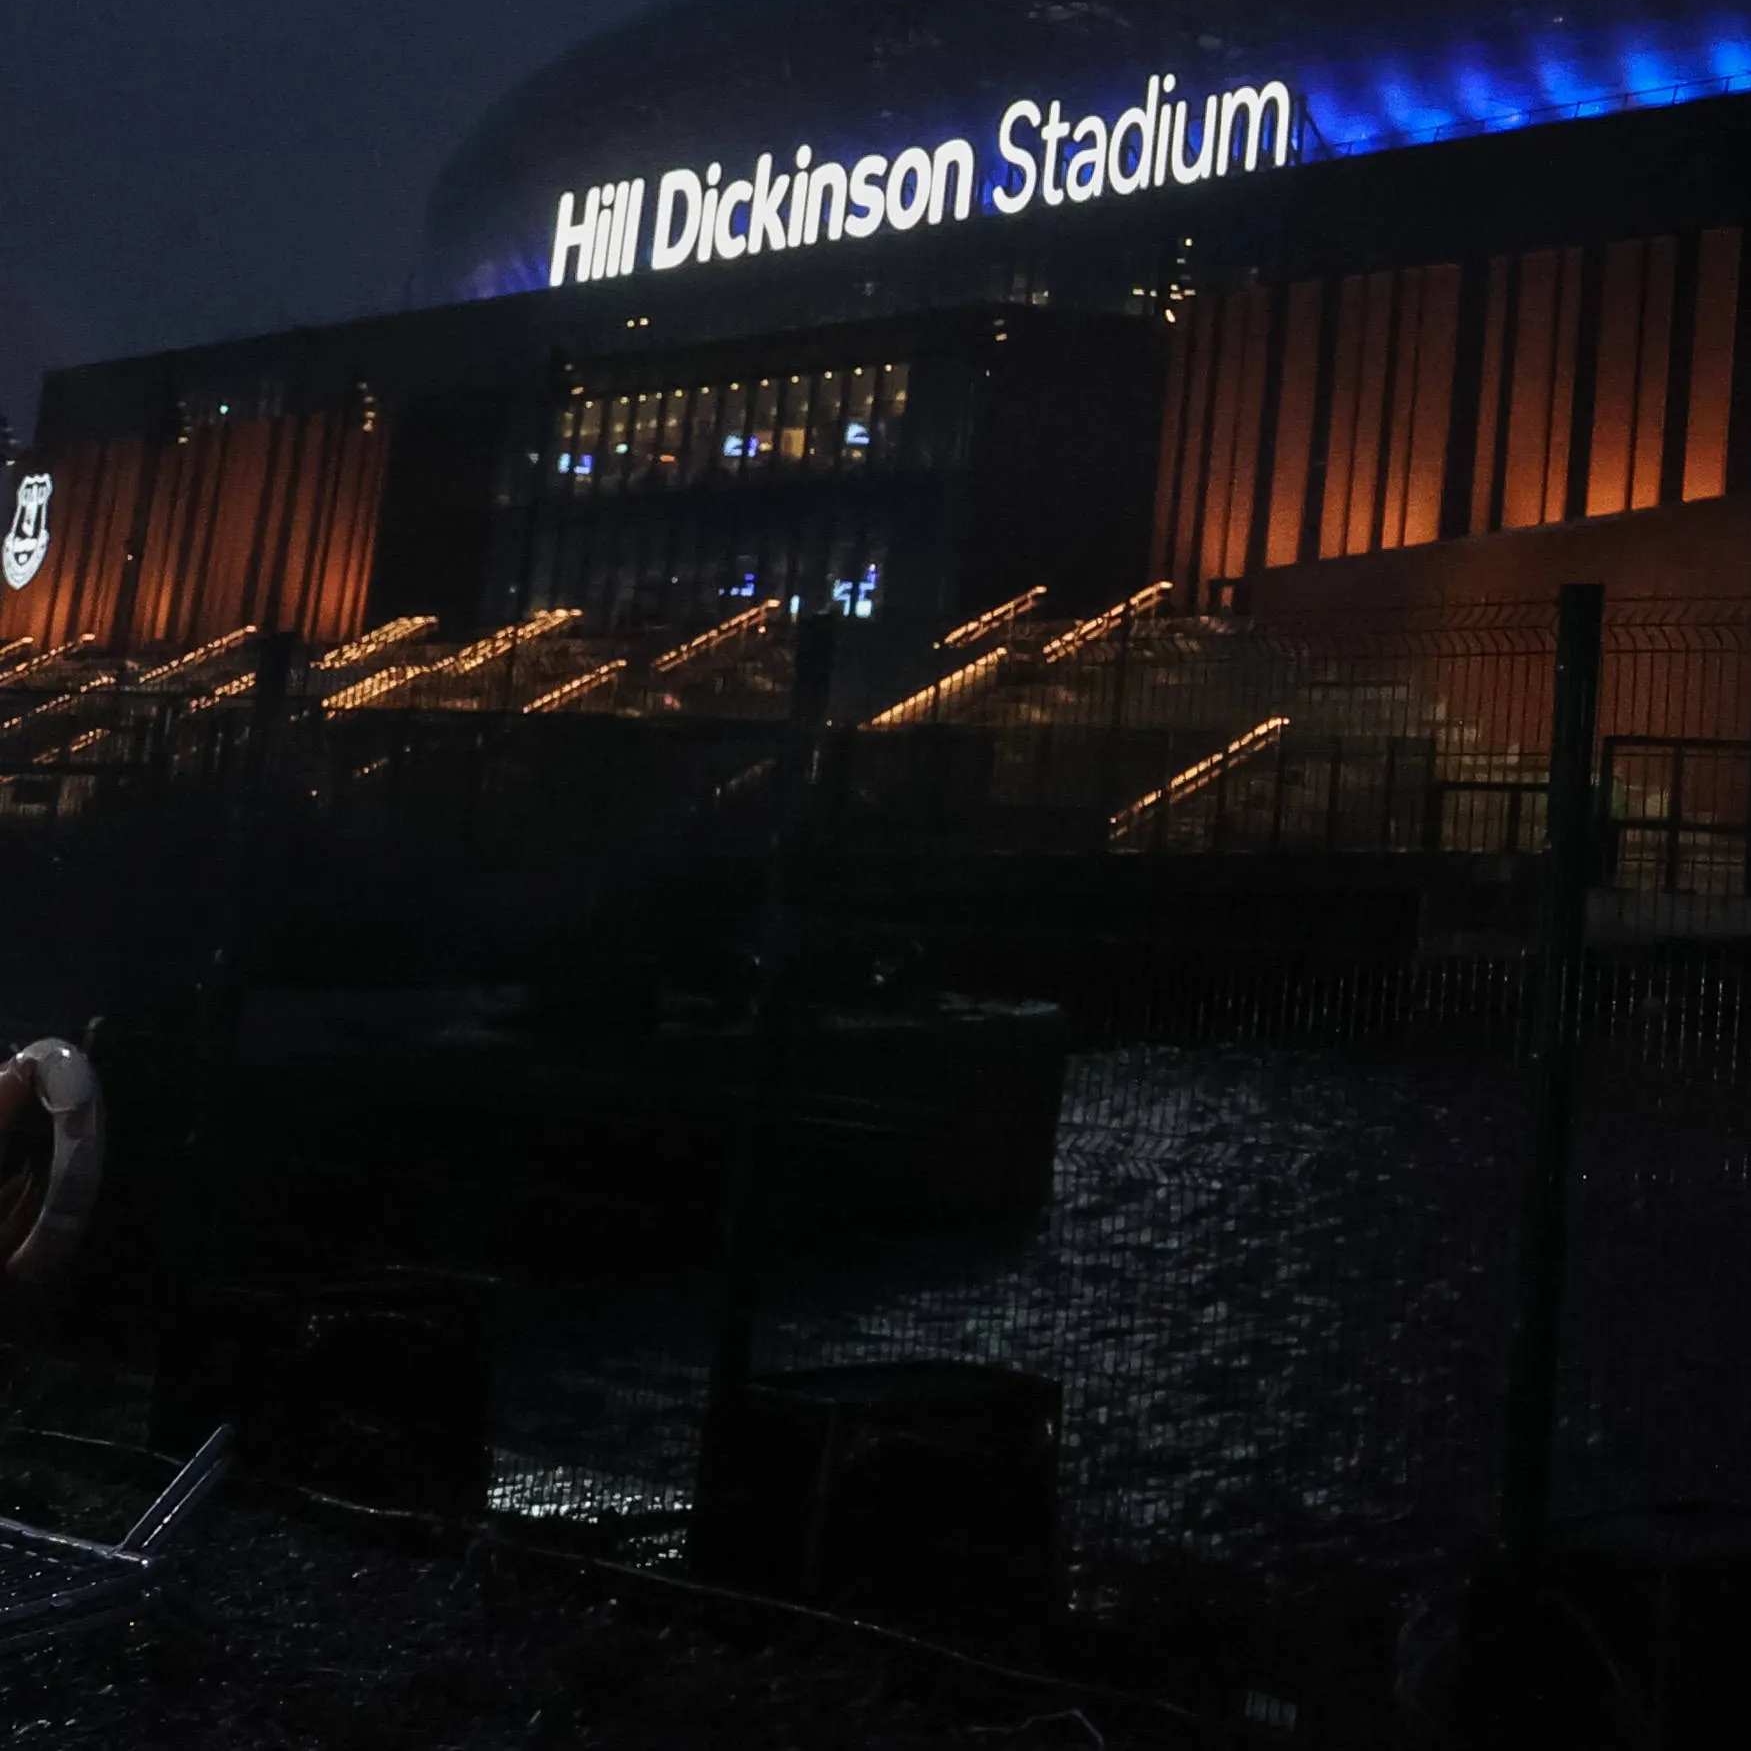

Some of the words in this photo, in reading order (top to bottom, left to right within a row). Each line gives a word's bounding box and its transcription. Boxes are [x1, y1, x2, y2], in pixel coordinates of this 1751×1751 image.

[549, 177, 643, 287] Hill
[650, 137, 976, 270] Dickinson
[993, 73, 1290, 213] Stadium
